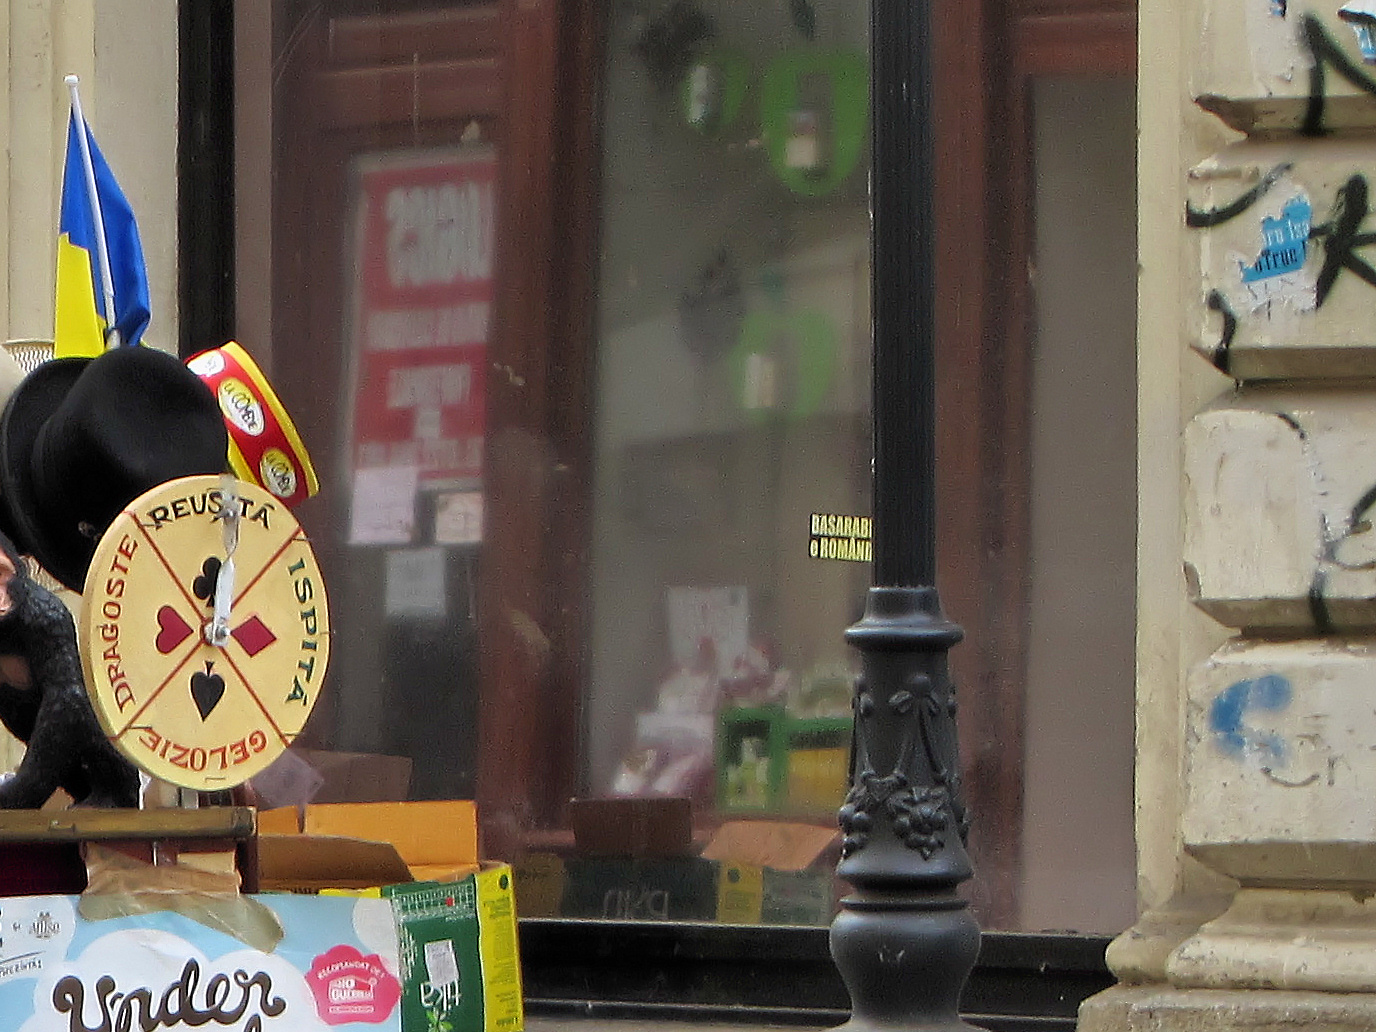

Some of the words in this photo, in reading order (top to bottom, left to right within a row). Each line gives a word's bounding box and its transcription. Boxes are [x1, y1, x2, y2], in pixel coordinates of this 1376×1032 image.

[144, 488, 276, 529] REUȘTĂ
[100, 534, 139, 712] DRAGOSTE
[286, 557, 319, 706] ISPITĂ
[138, 728, 269, 771] GELOZIE
